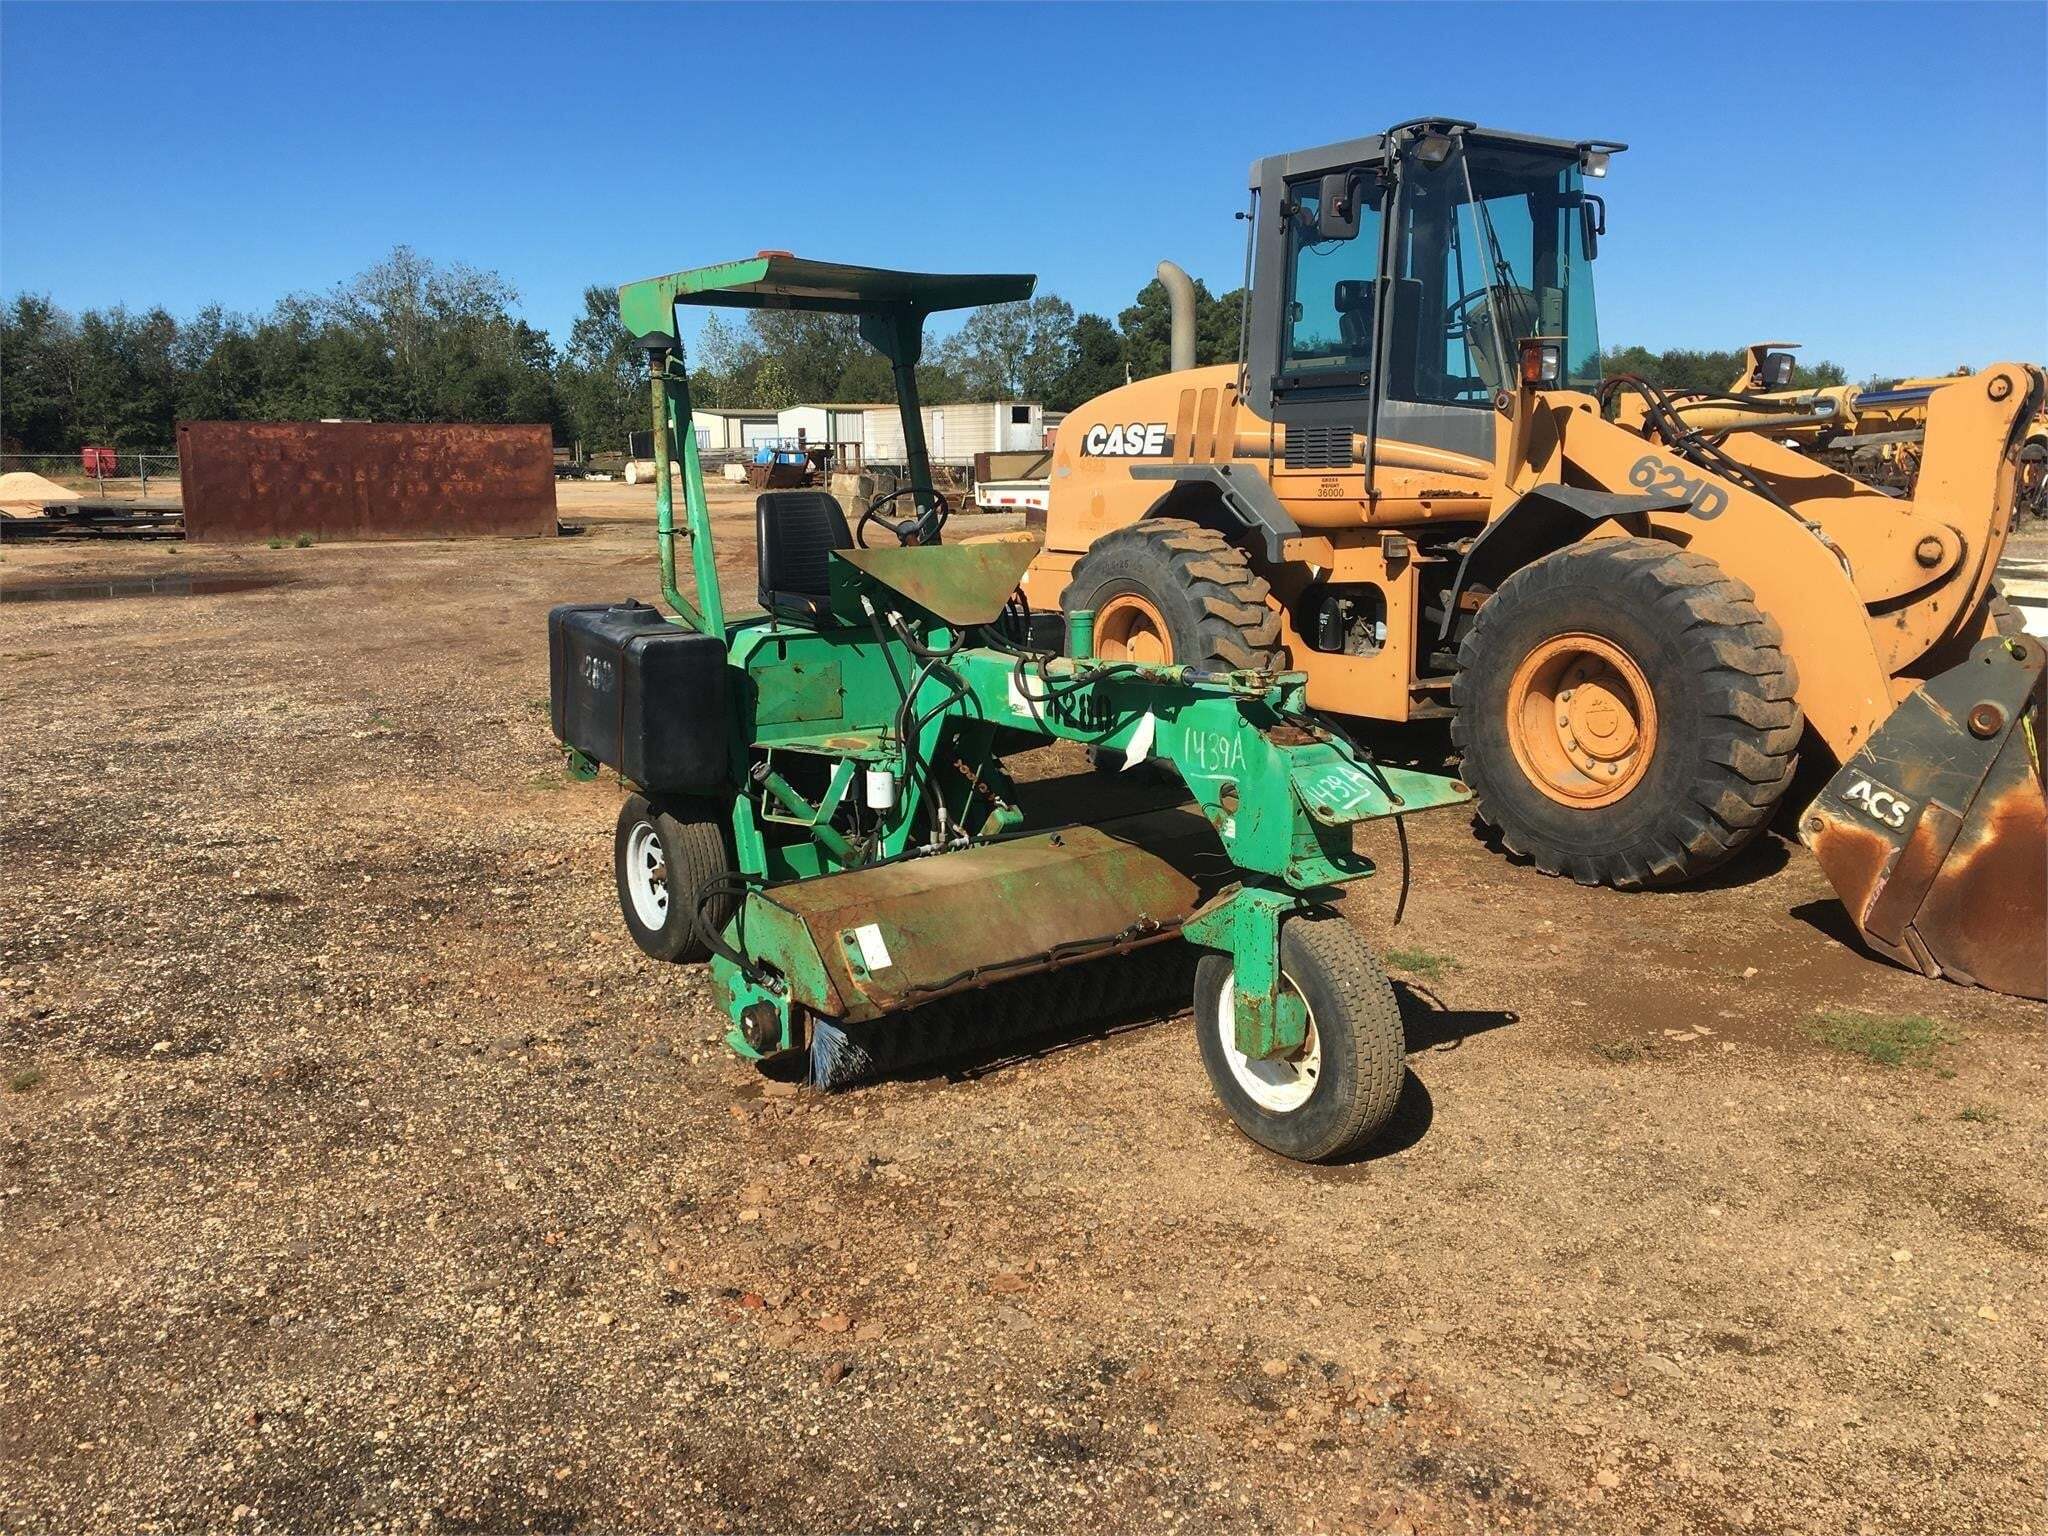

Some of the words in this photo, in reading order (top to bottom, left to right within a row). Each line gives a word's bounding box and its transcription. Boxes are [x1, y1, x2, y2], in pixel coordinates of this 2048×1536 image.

[1086, 423, 1167, 456] CASE
[1317, 488, 1345, 497] 36000
[1629, 455, 1728, 521] 621D
[1184, 727, 1247, 771] 1439A
[1841, 780, 1911, 828] ACS
